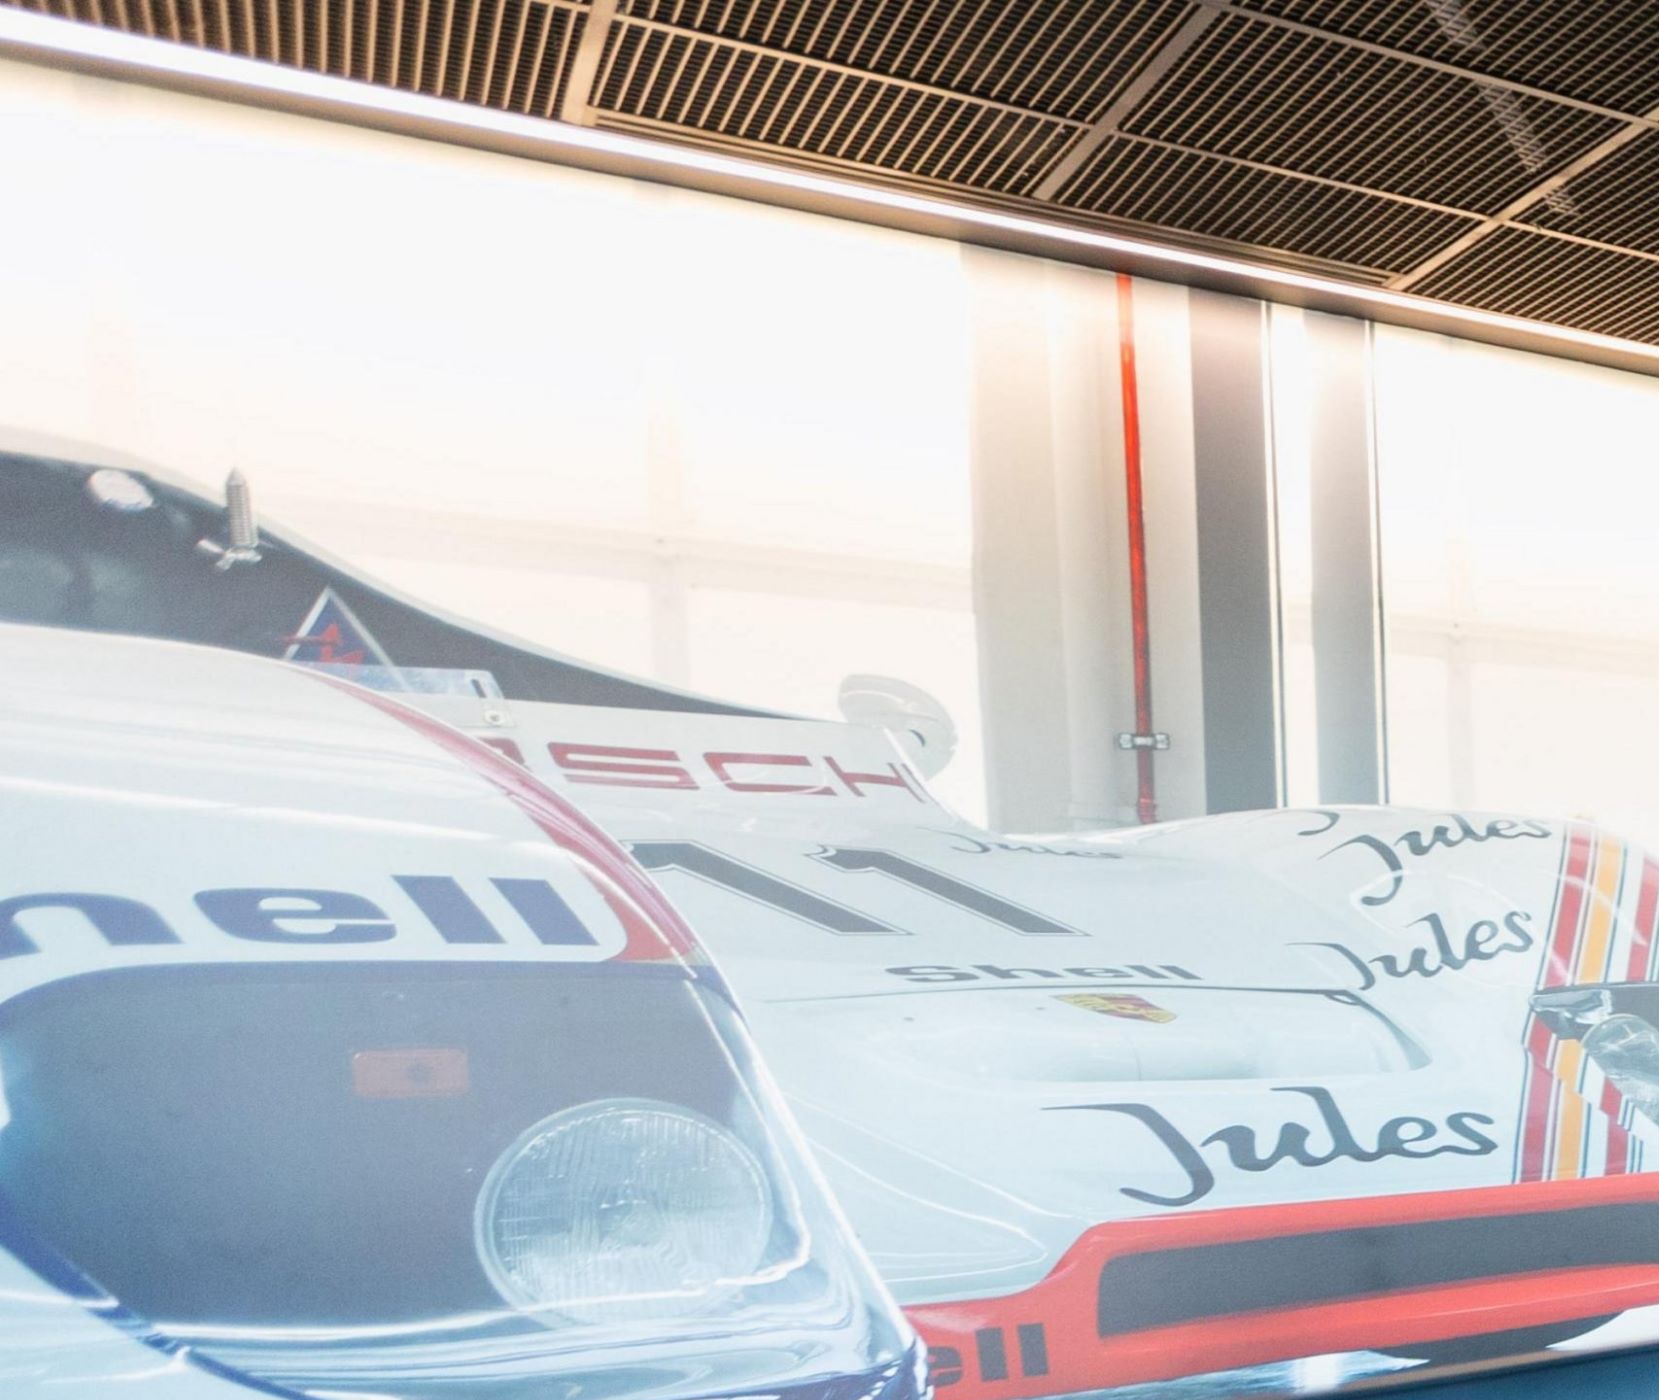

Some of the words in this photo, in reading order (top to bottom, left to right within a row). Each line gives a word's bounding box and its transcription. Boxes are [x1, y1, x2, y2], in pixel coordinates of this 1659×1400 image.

[628, 838, 1093, 936] 11
[1317, 813, 1552, 905] Jules
[885, 963, 1202, 983] Shell
[1283, 911, 1534, 990] Jules
[1040, 1087, 1499, 1206] Jules
